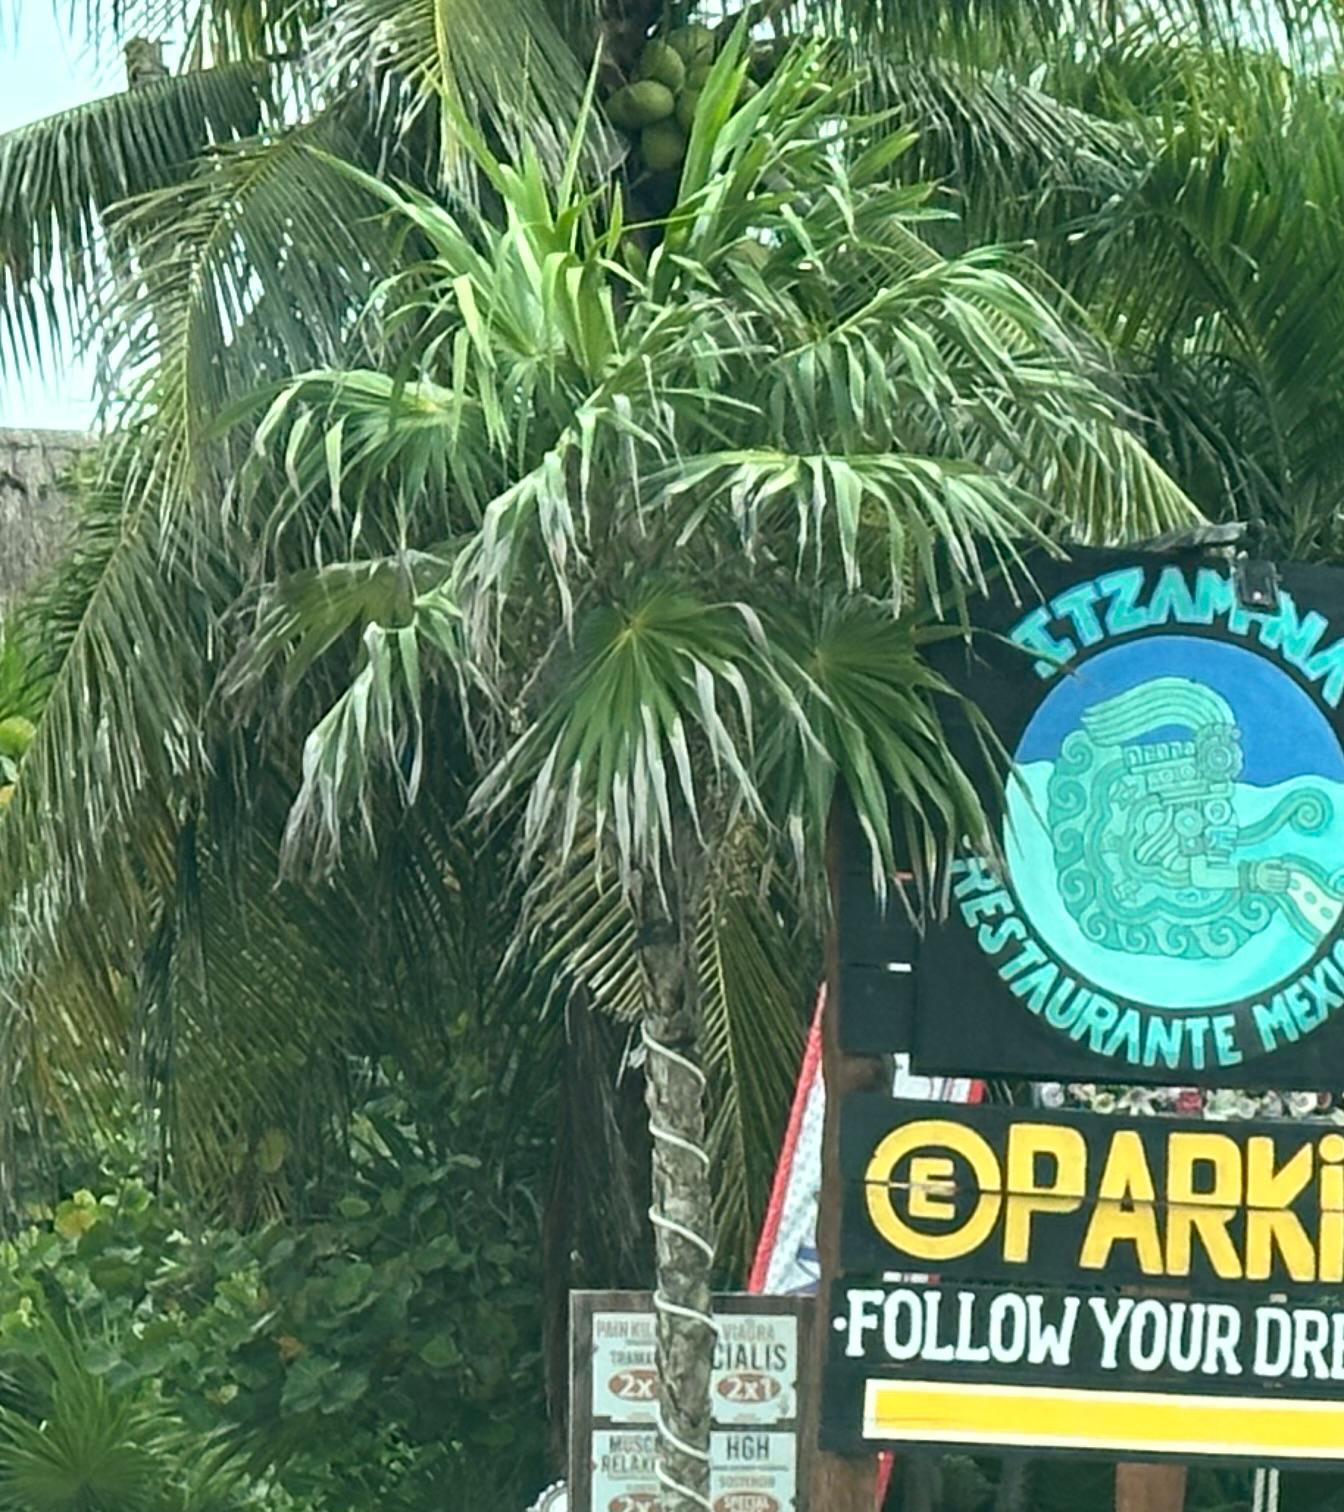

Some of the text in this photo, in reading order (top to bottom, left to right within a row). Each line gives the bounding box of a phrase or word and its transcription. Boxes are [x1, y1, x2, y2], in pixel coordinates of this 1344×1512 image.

[952, 856, 1243, 1072] RESTAURANTE
[713, 1343, 788, 1371] CIALIS
[1093, 1298, 1241, 1376] YOUR
[726, 1436, 771, 1461] HGH
